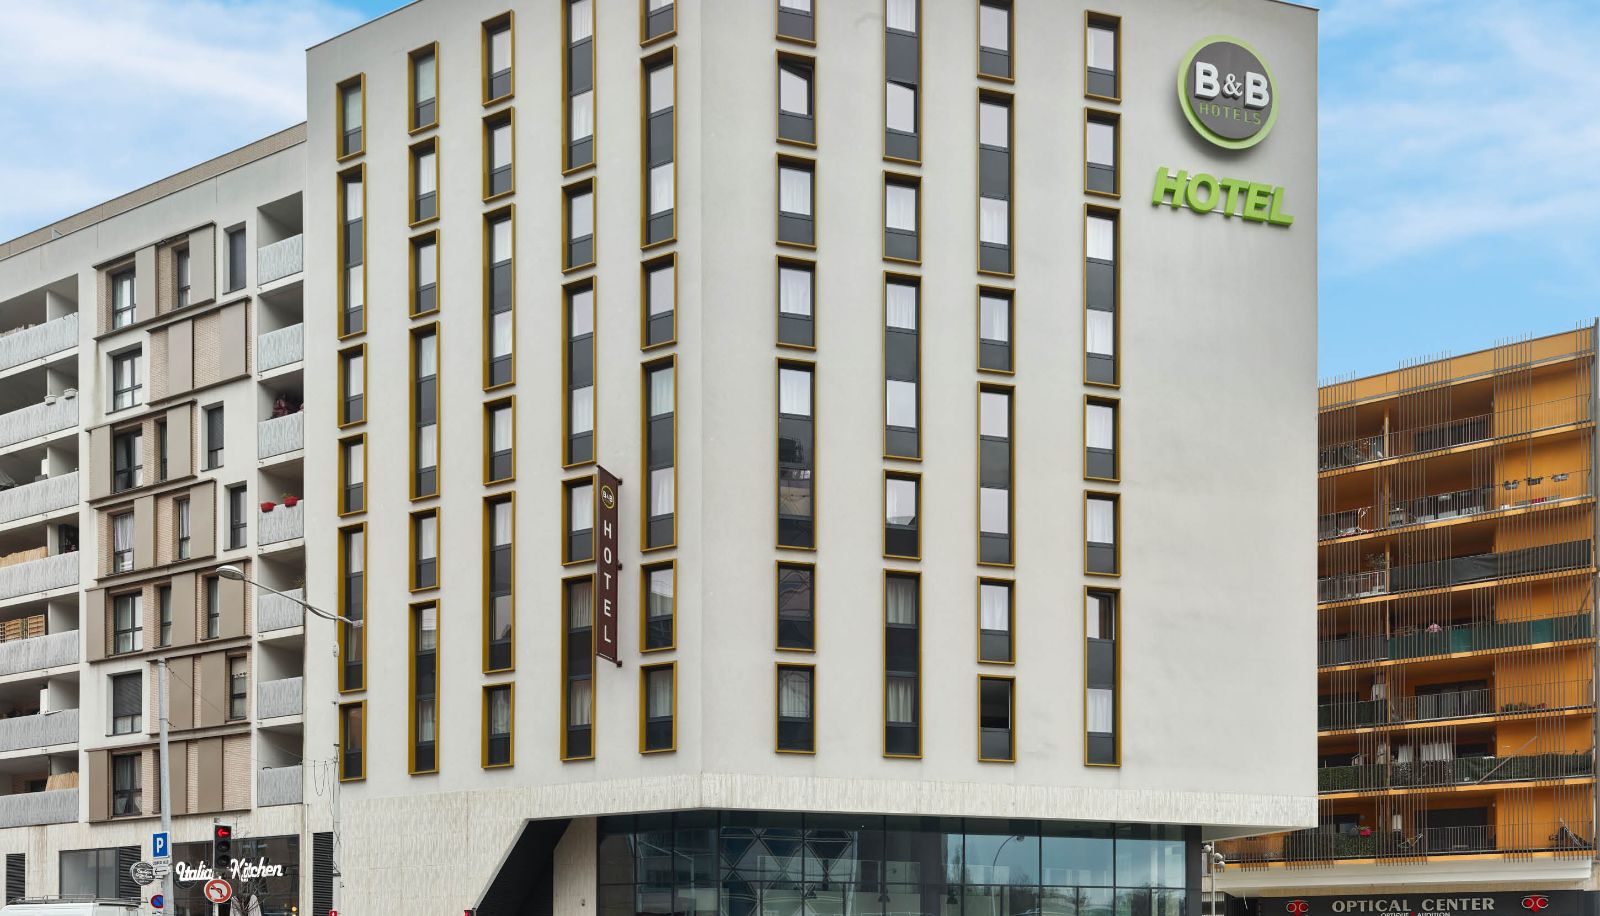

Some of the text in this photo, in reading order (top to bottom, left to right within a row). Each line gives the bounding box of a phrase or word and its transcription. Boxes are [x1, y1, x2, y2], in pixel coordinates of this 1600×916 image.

[1194, 61, 1270, 109] B&B
[1199, 103, 1262, 125] HOTELS
[1152, 166, 1294, 228] HOTEL
[603, 519, 612, 643] HOTEL
[156, 837, 164, 853] P
[229, 856, 284, 881] Kitchen
[1331, 897, 1495, 913] OPTICAL CENTER
